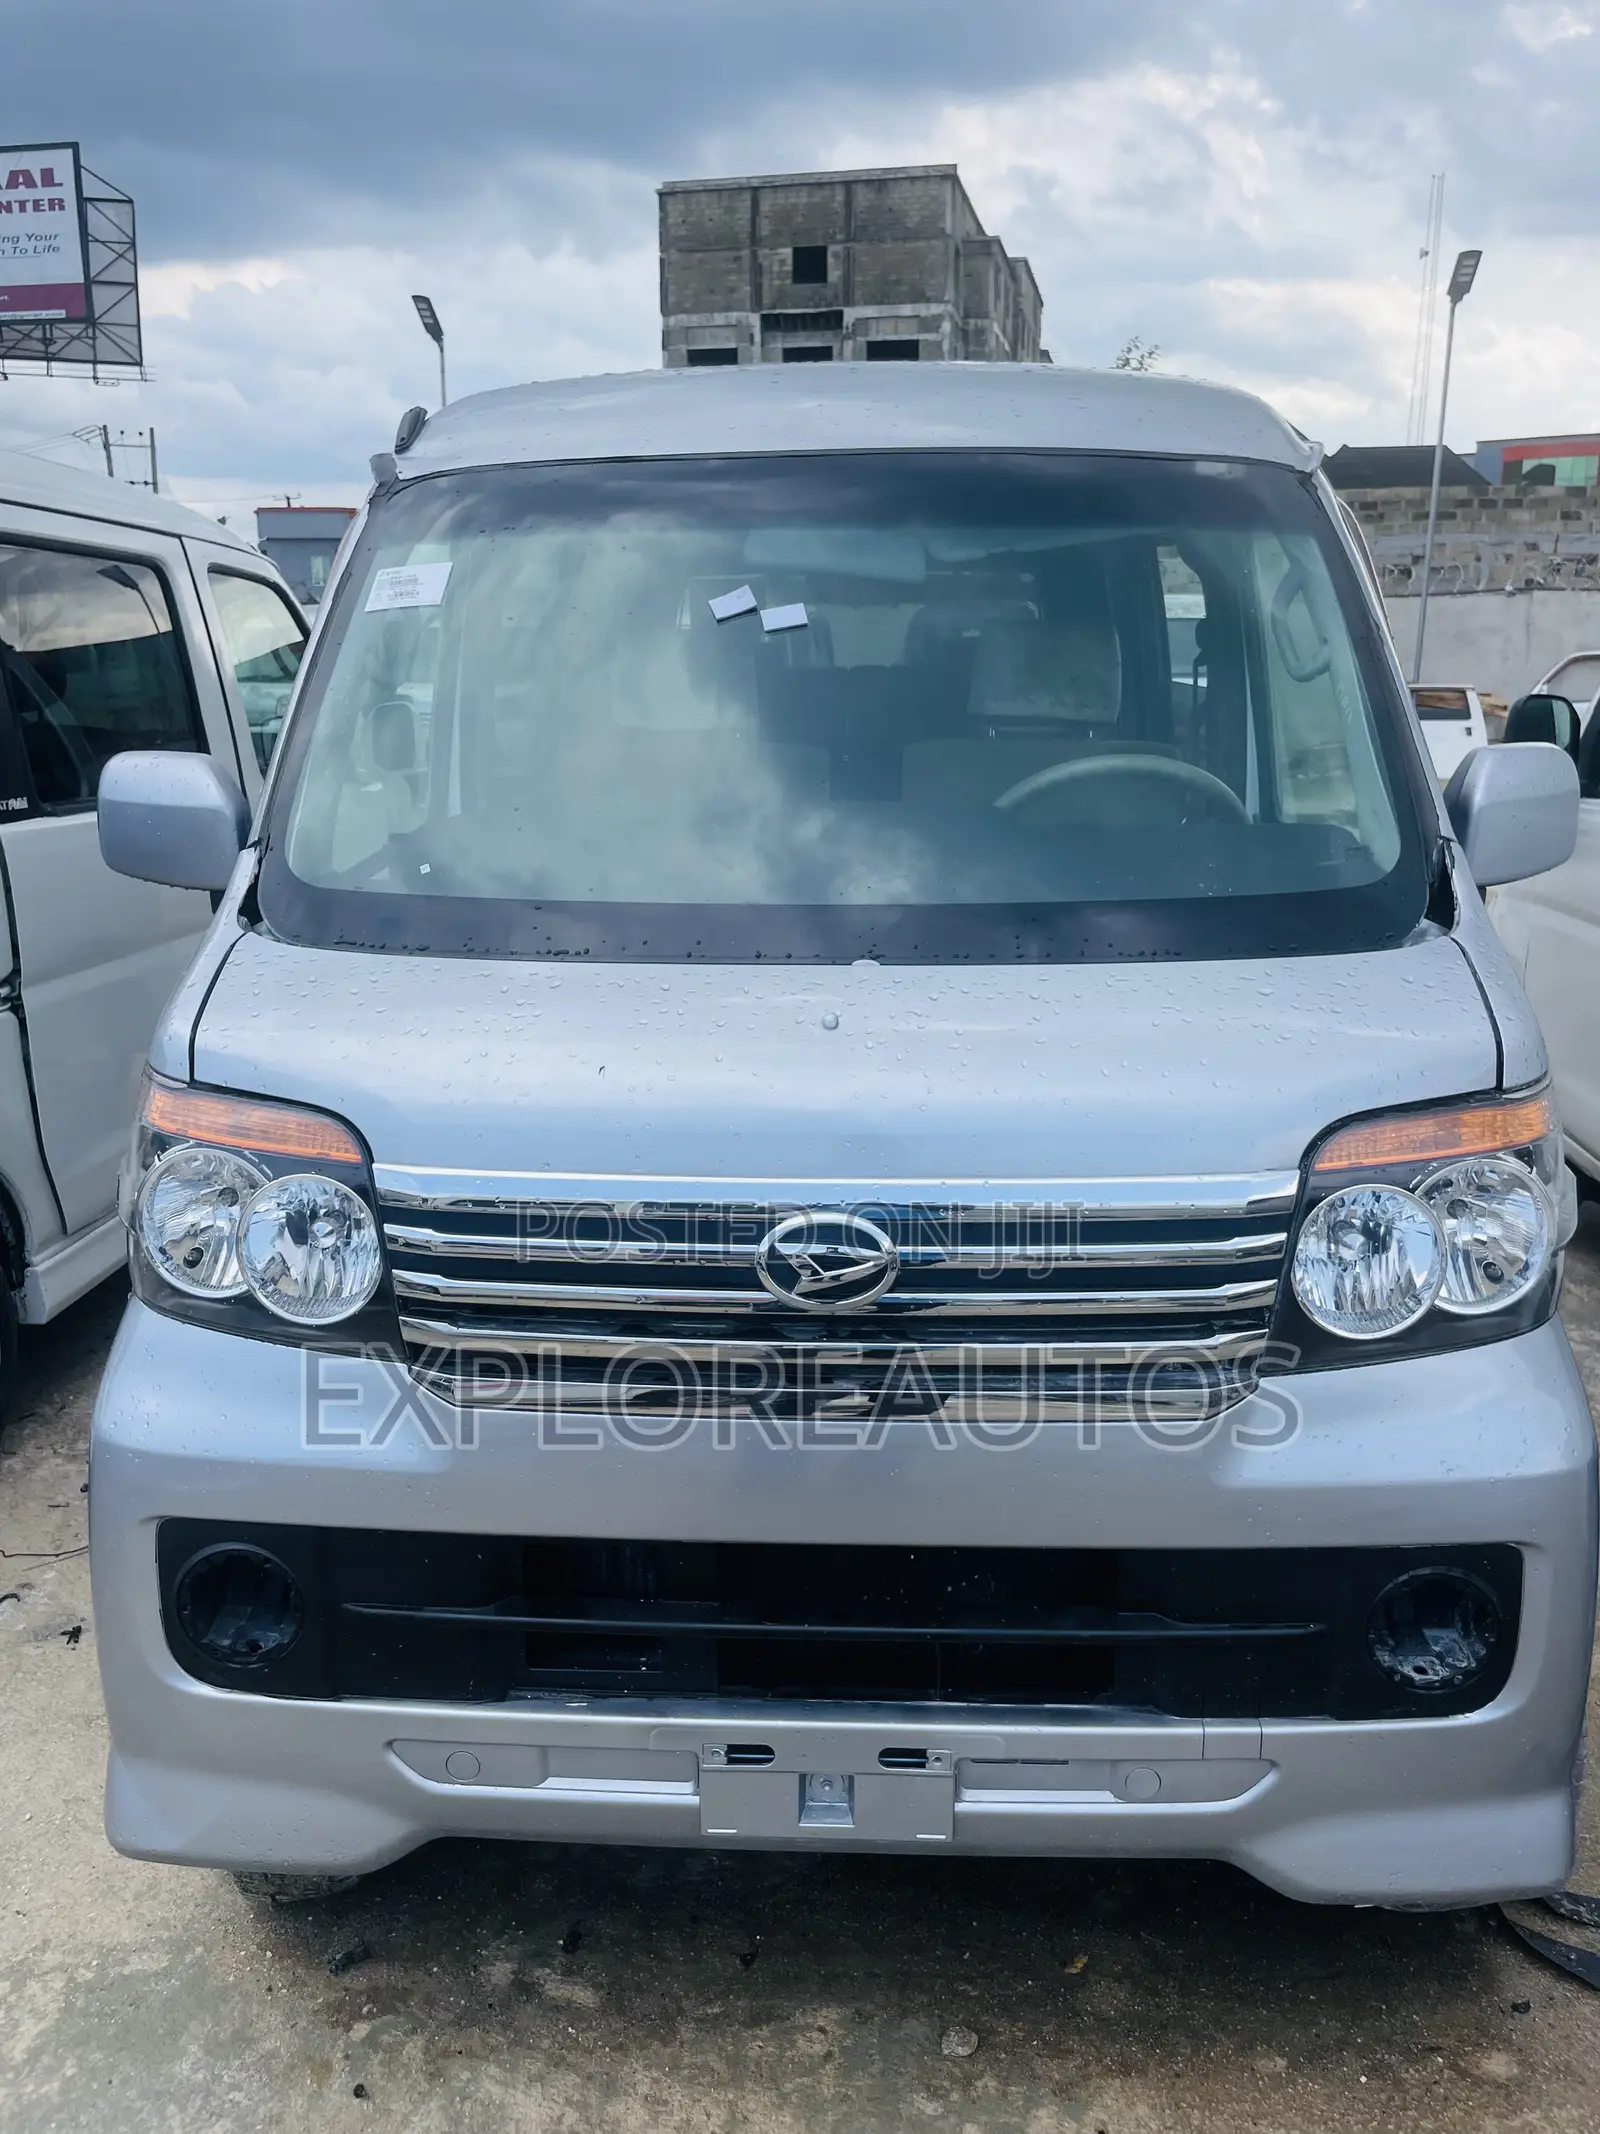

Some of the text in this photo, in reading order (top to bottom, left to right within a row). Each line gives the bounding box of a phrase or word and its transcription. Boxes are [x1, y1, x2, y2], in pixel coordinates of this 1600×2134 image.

[0, 168, 63, 190] AL
[25, 232, 60, 242] Your
[11, 246, 28, 255] To
[33, 244, 60, 254] Life
